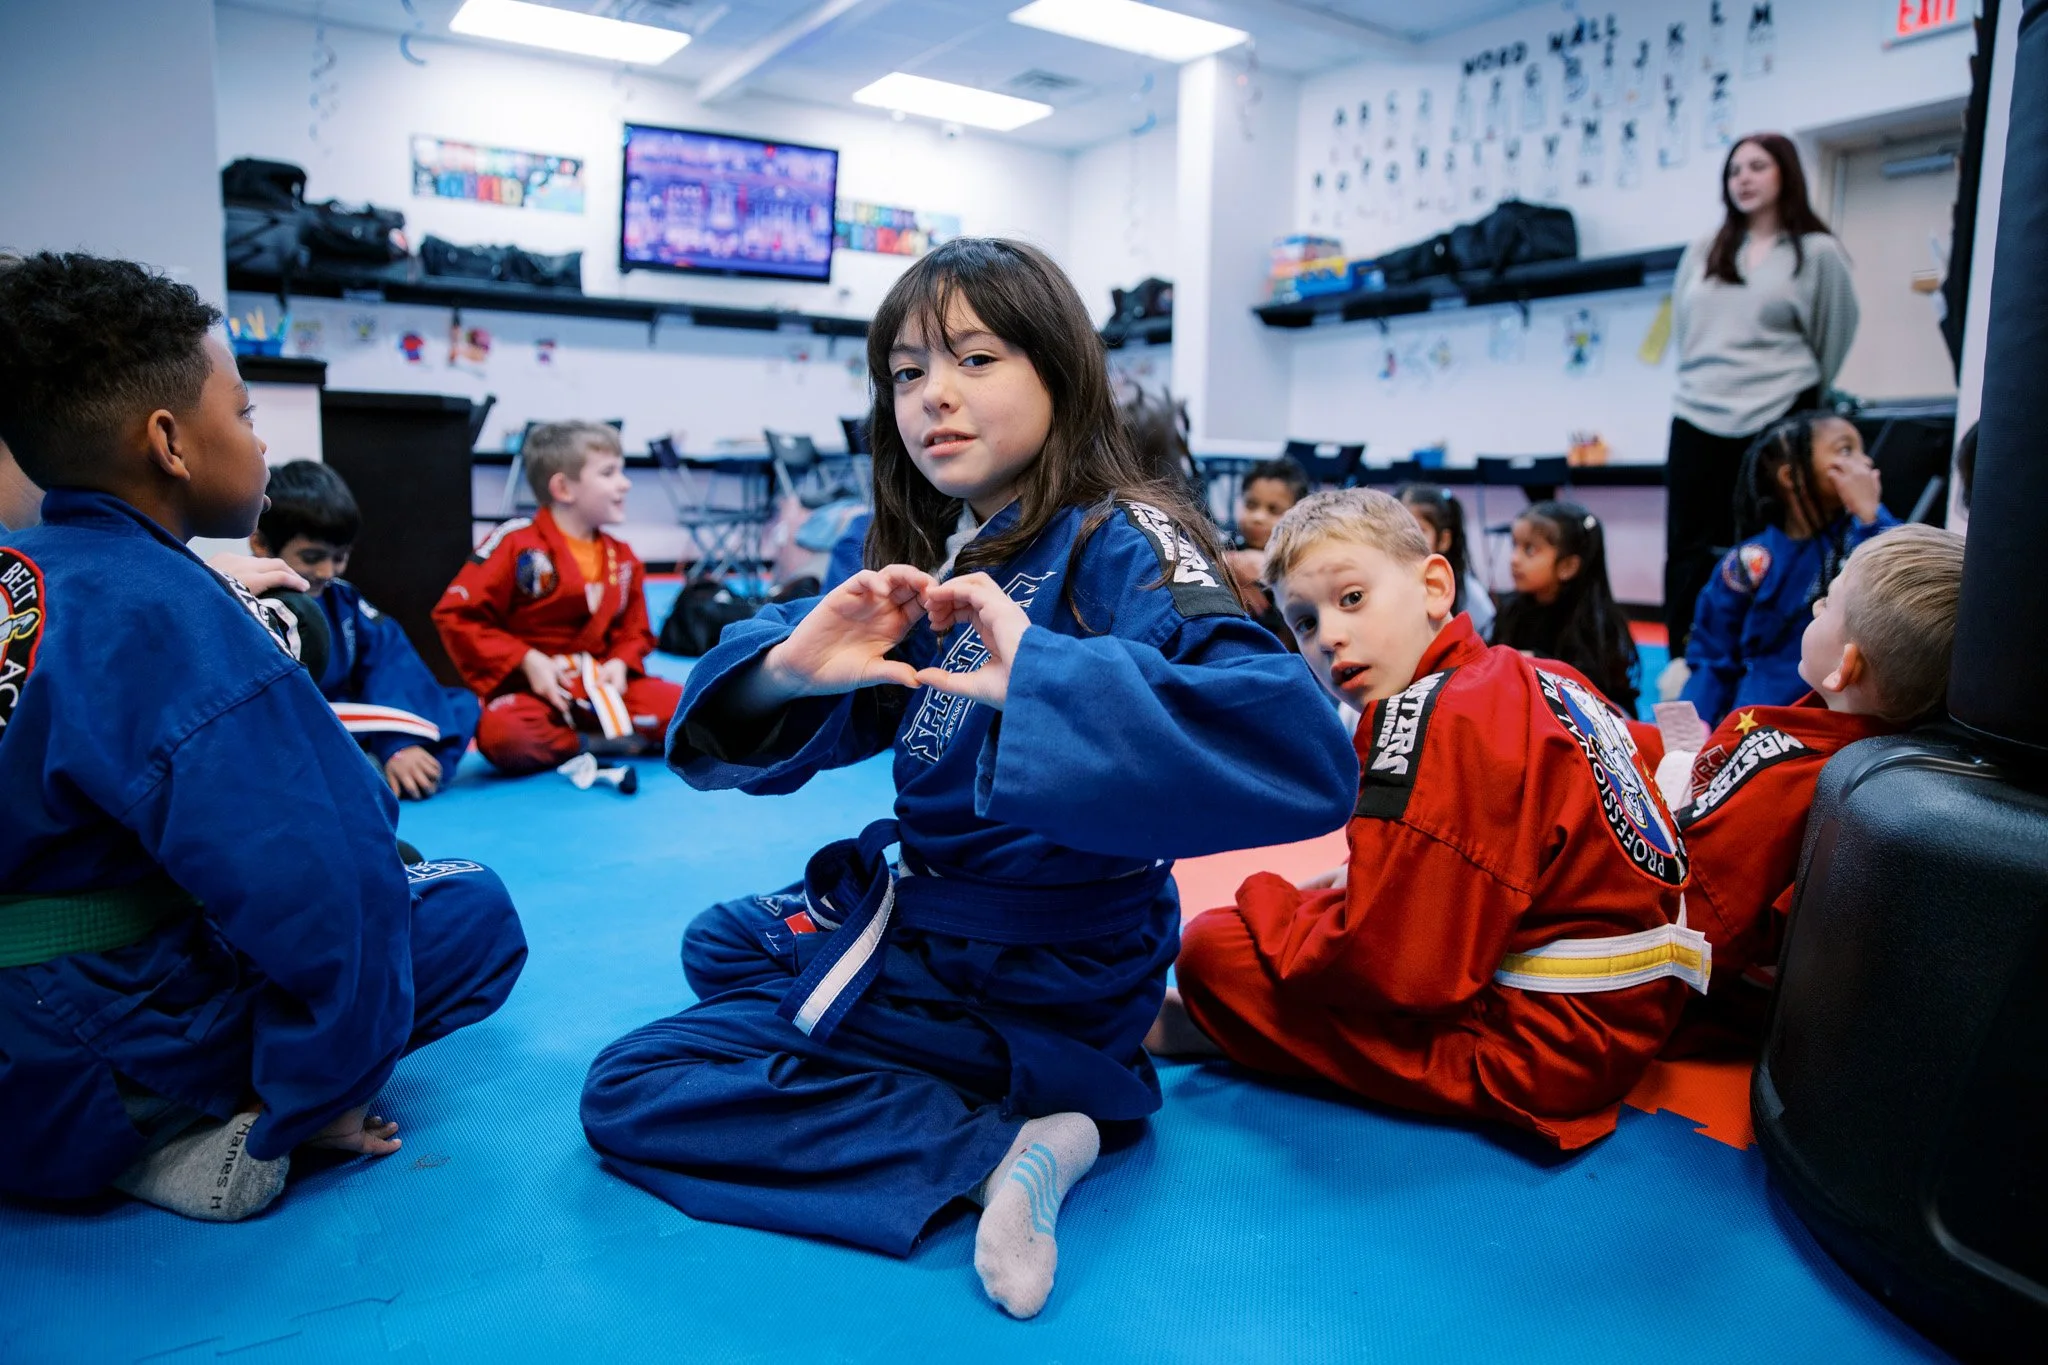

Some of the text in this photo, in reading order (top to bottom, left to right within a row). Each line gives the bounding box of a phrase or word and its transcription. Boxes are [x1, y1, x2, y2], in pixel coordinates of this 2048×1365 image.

[1, 562, 37, 608] BELT
[945, 697, 965, 738] PROFESSION
[1557, 713, 1665, 878] PROFESSIONAL
[1692, 729, 1805, 818] MASTERS
[217, 1122, 252, 1188] Hanes
